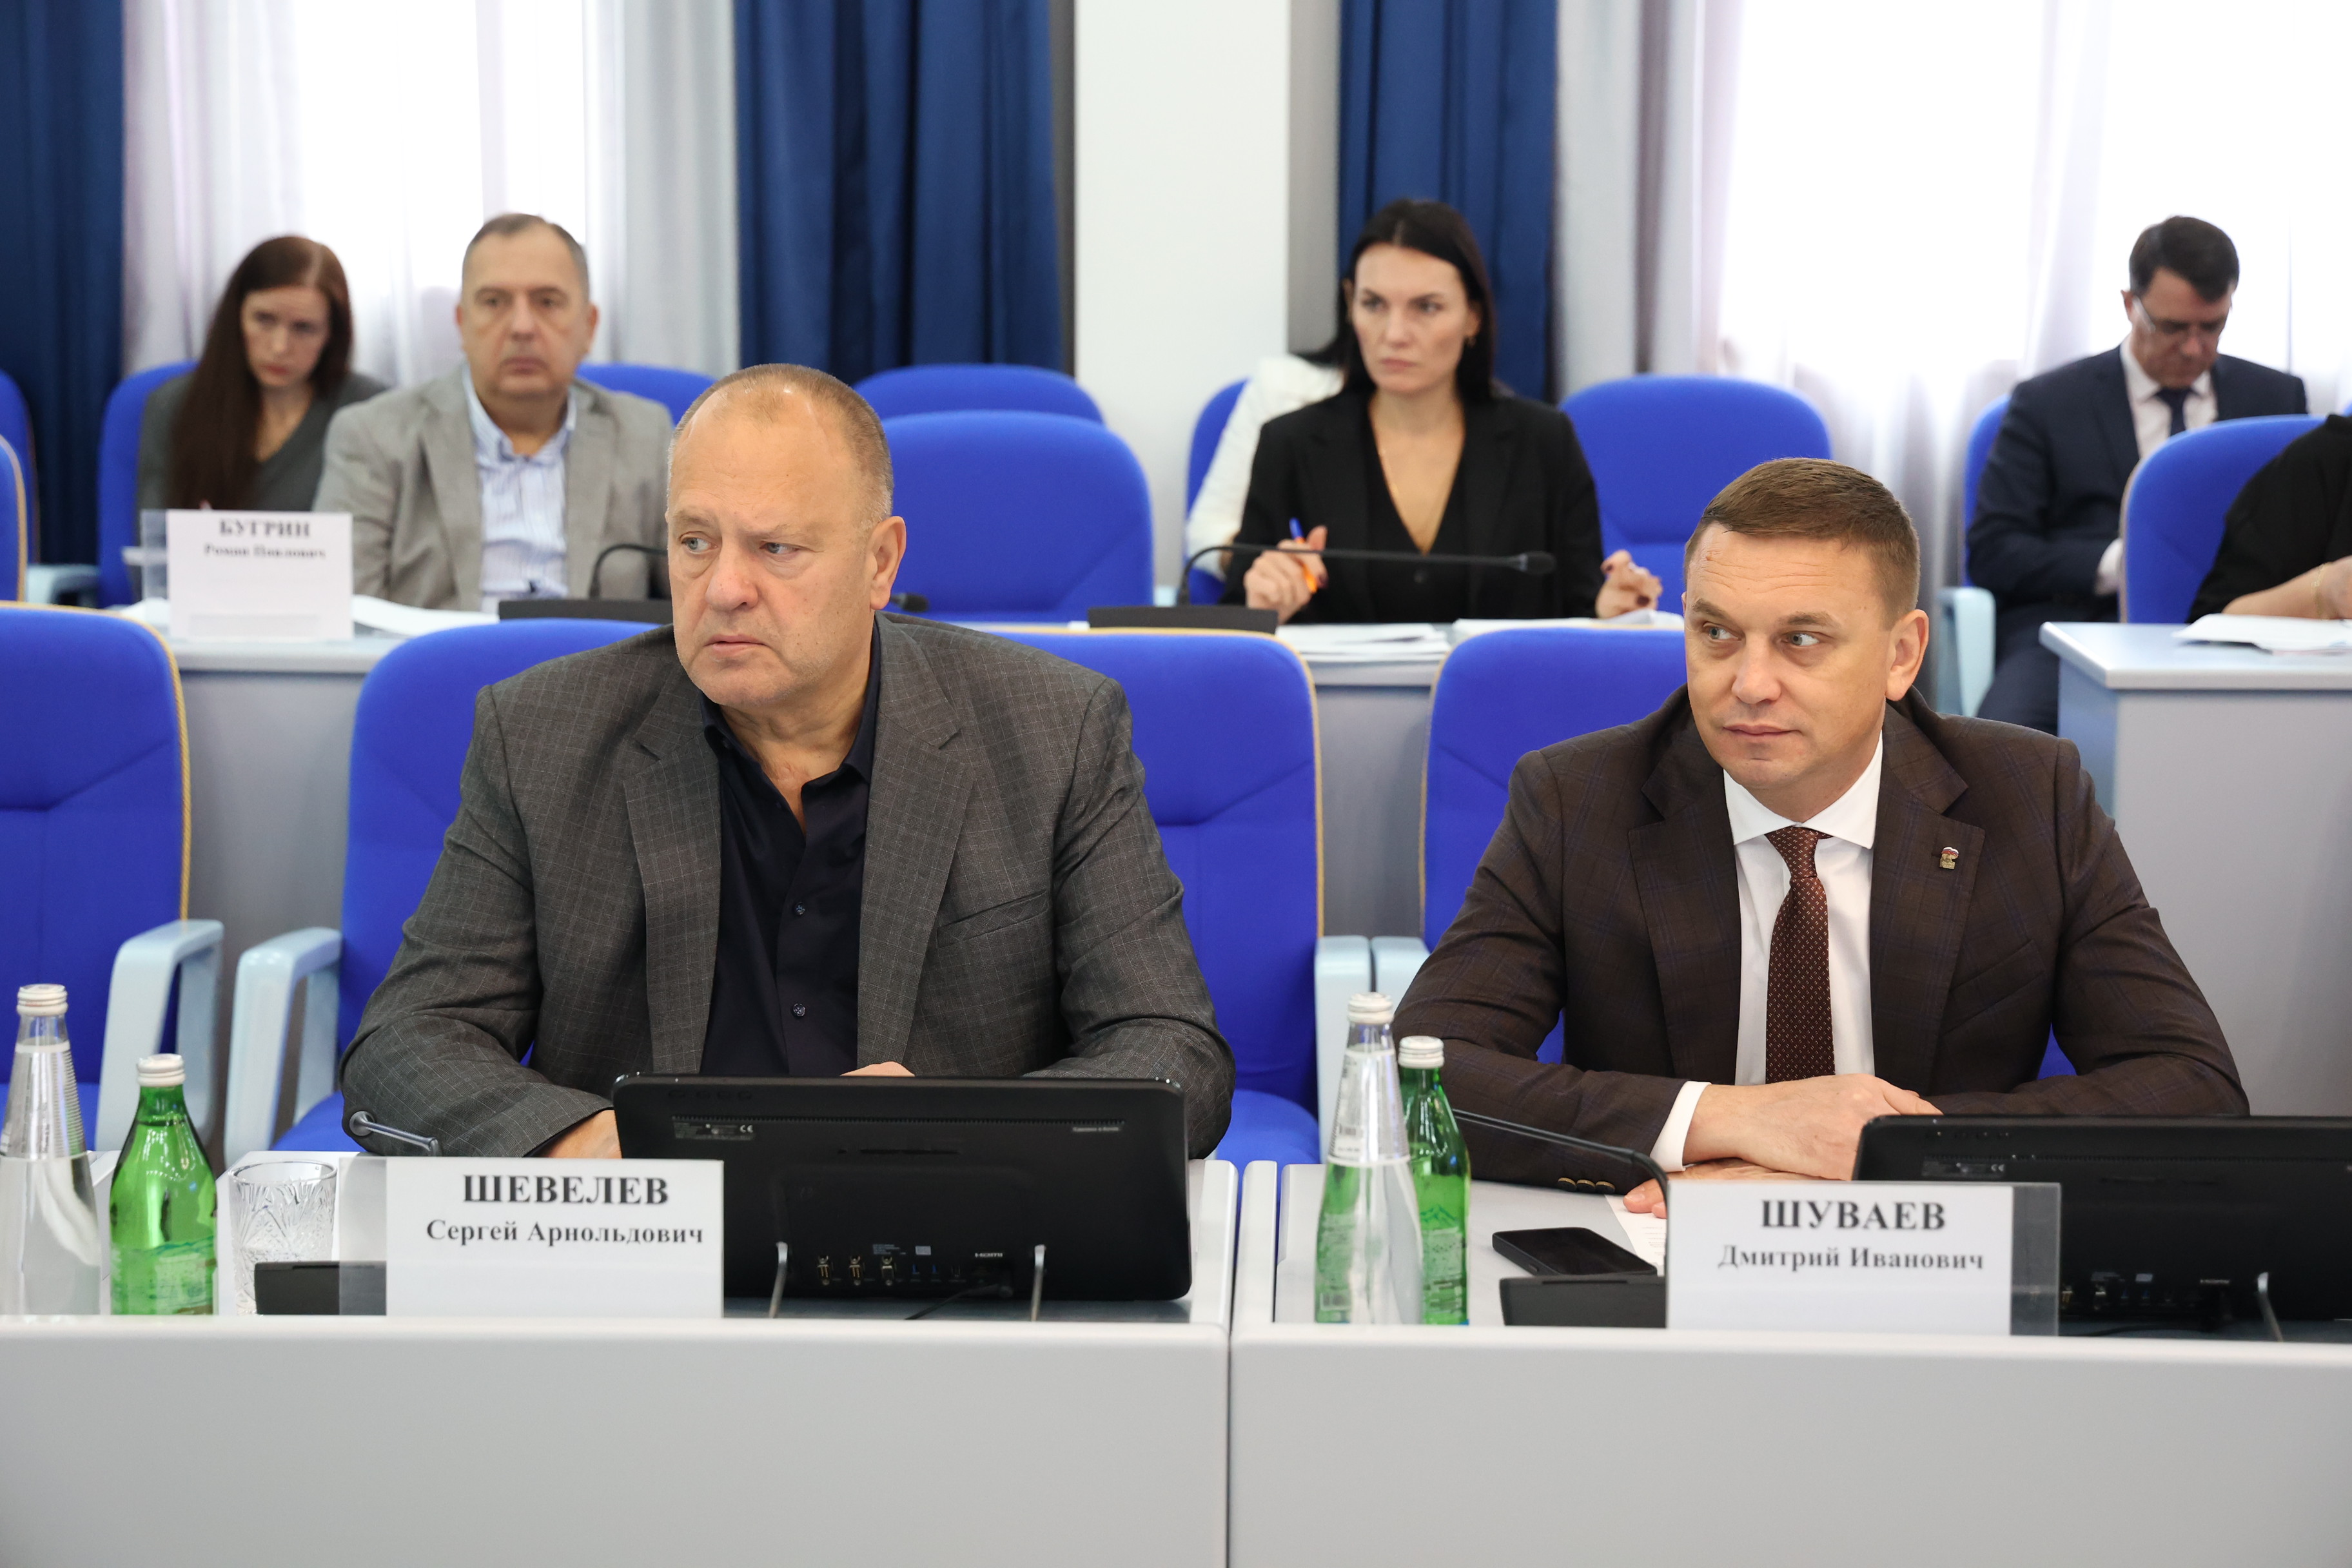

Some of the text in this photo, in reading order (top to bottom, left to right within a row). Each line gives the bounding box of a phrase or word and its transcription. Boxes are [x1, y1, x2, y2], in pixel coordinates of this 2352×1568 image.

[463, 1174, 669, 1206] ШЕВЕЛЕВ
[1761, 1199, 1946, 1231] ШУВАЕВ
[426, 1219, 703, 1248] Сергей Арнольдович
[1718, 1244, 1983, 1272] Дмитрий Иванович
